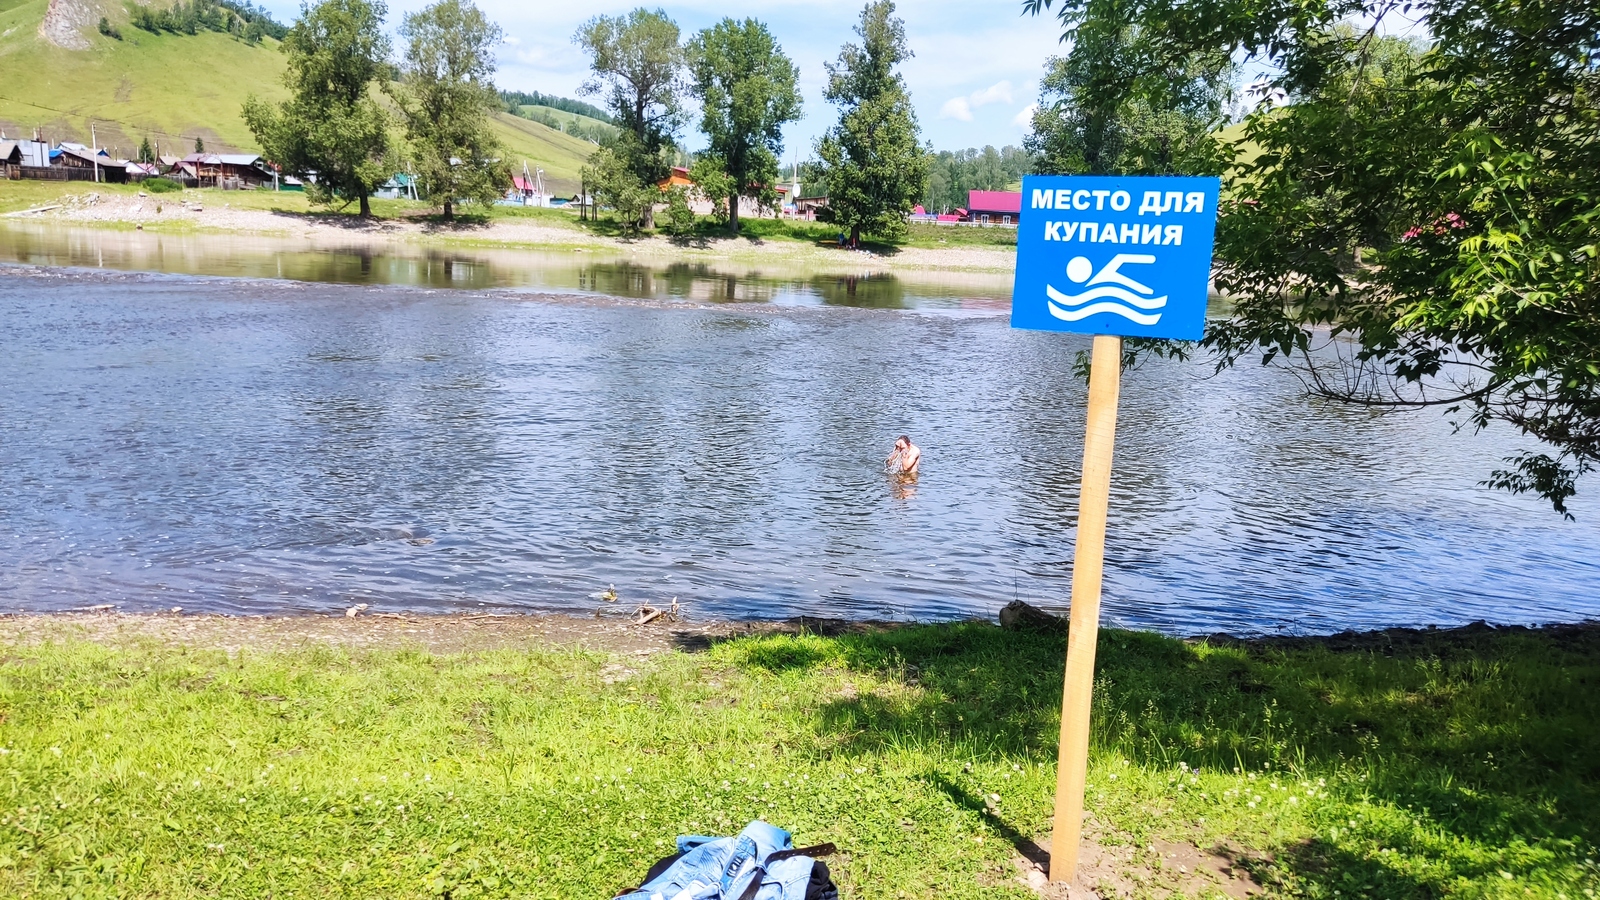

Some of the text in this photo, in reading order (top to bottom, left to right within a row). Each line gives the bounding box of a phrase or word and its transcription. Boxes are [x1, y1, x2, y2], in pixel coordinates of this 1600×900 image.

[1031, 188, 1205, 216] МЕСТО ДЛЯ
[1044, 220, 1183, 246] КУПАНИЯ
